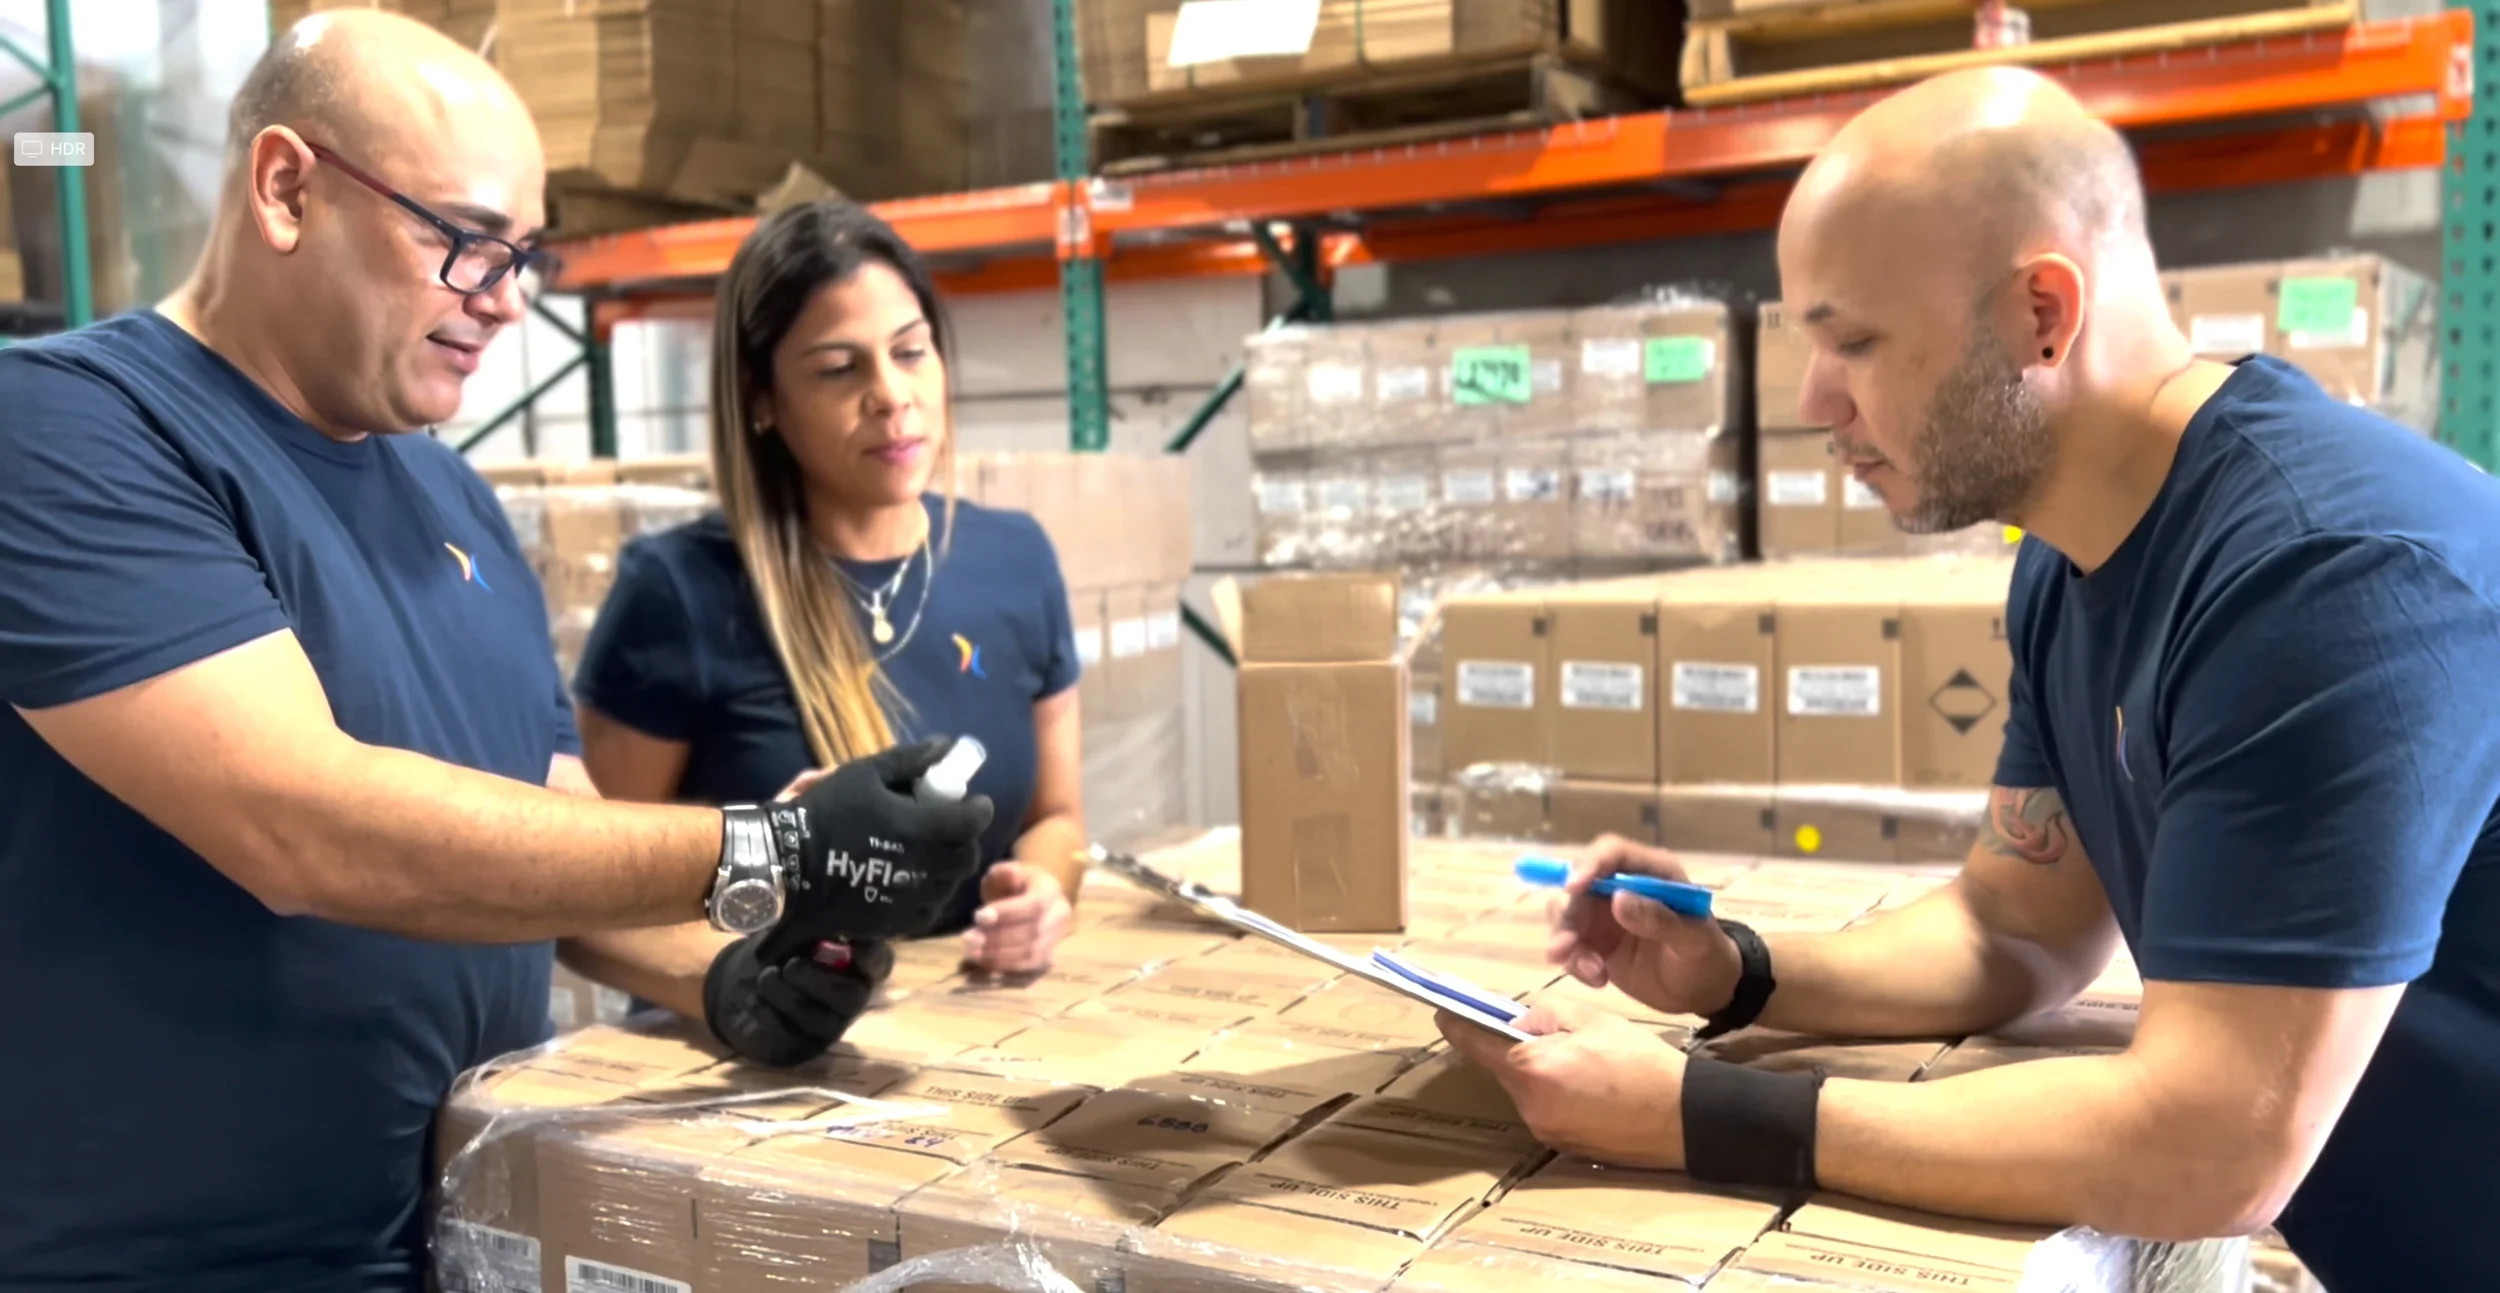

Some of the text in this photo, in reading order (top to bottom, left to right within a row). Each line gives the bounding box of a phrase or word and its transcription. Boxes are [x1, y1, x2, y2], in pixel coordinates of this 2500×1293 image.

[925, 1086, 962, 1098] THIS
[963, 1090, 1003, 1102] SIDE
[1269, 1181, 1300, 1192] UP
[1305, 1186, 1351, 1200] SIDE
[1352, 1195, 1400, 1210] THIS
[1519, 1226, 1665, 1255] THIS SIDE UP
[1810, 1254, 1970, 1286] THIS SIDE UP
